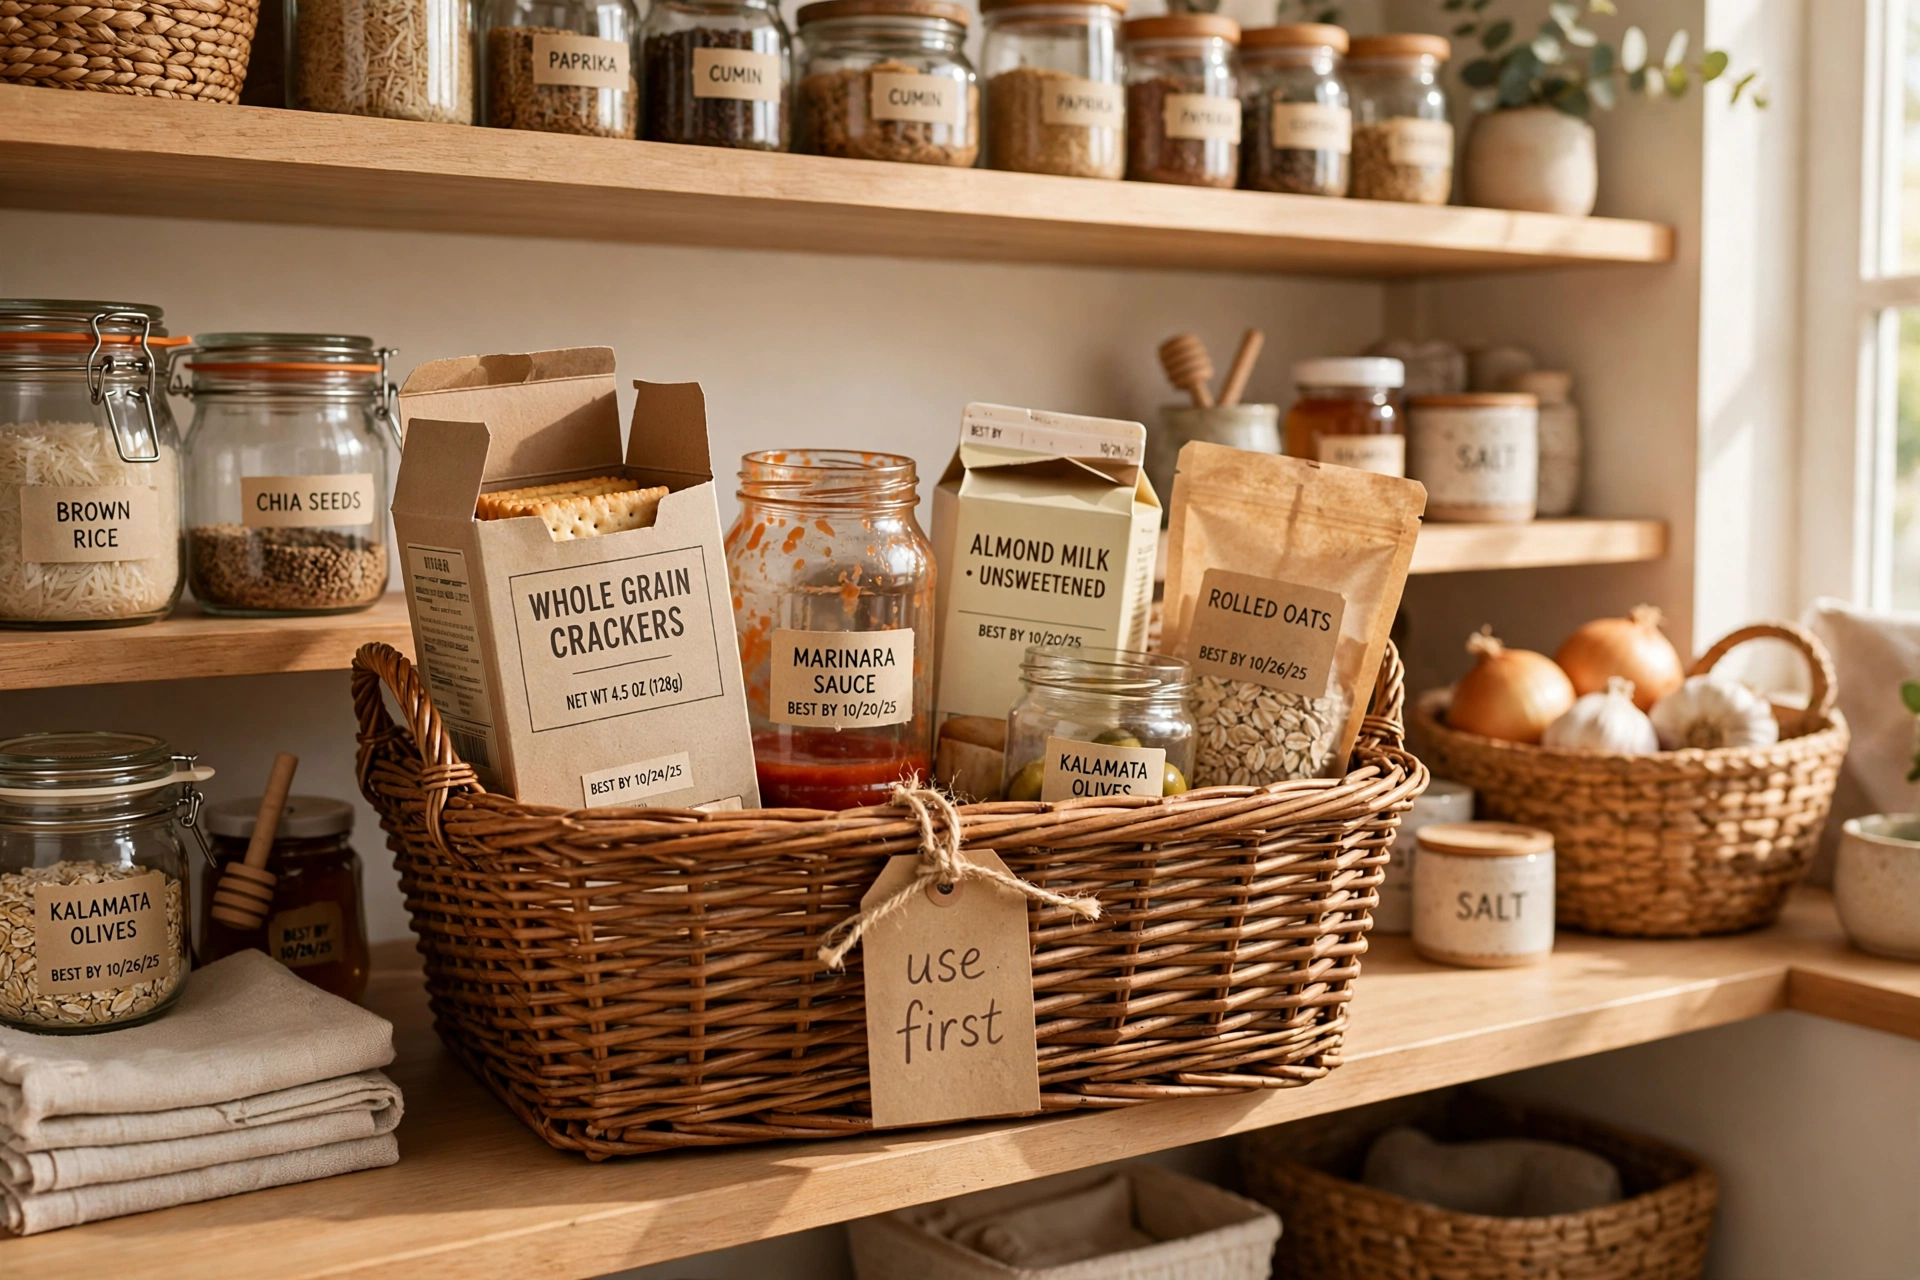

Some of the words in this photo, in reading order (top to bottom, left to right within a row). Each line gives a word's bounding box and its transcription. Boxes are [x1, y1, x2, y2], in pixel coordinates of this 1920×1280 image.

[549, 51, 617, 74] PAPRIKA
[709, 65, 762, 85] CUMIN
[888, 88, 942, 108] CUMIN
[971, 424, 989, 438] BEST
[992, 429, 1003, 438] BY
[1456, 444, 1517, 473] SALT
[57, 501, 130, 523] BROWN
[256, 493, 302, 512] CHIA
[309, 491, 361, 511] SEEDS
[73, 528, 119, 549] RICE
[970, 533, 1054, 563] ALMOND
[1061, 544, 1110, 572] MILK
[528, 581, 615, 621] WHOLE
[621, 567, 691, 606] GRAIN
[979, 565, 1106, 599] UNSWEETENED
[1208, 588, 1278, 619] ROLLED
[1283, 604, 1332, 632] OATS
[550, 606, 684, 658] CRACKERS
[979, 624, 1006, 640] BEST
[1009, 628, 1025, 642] BY
[1029, 631, 1082, 648] 10/20/25
[793, 647, 896, 668] MARINARA
[1199, 645, 1227, 664] BEST
[1230, 653, 1247, 668] BY
[1250, 657, 1308, 681] 10/26/25
[566, 691, 588, 711] NET
[591, 687, 609, 706] WT
[611, 683, 628, 701] 4.5
[631, 681, 646, 698] OZ
[649, 672, 683, 698] (128g)
[813, 674, 876, 694] SAUCE
[787, 701, 818, 716] BEST
[821, 703, 838, 717] BY
[842, 700, 897, 719] 10/20/25
[590, 778, 615, 795] BEST
[618, 776, 631, 790] BY
[634, 764, 683, 787] 10/24/25
[1060, 753, 1148, 780] KALAMATA
[1072, 778, 1132, 797] OLIVES
[50, 891, 151, 922] KALAMATA
[1457, 890, 1527, 921] SALT
[70, 919, 137, 946] OLIVES
[283, 927, 311, 943] BEST
[51, 966, 81, 982] BEST
[85, 963, 103, 979] BY
[106, 953, 160, 978] 10/26/25
[907, 947, 985, 984] use
[896, 998, 1004, 1065] first
